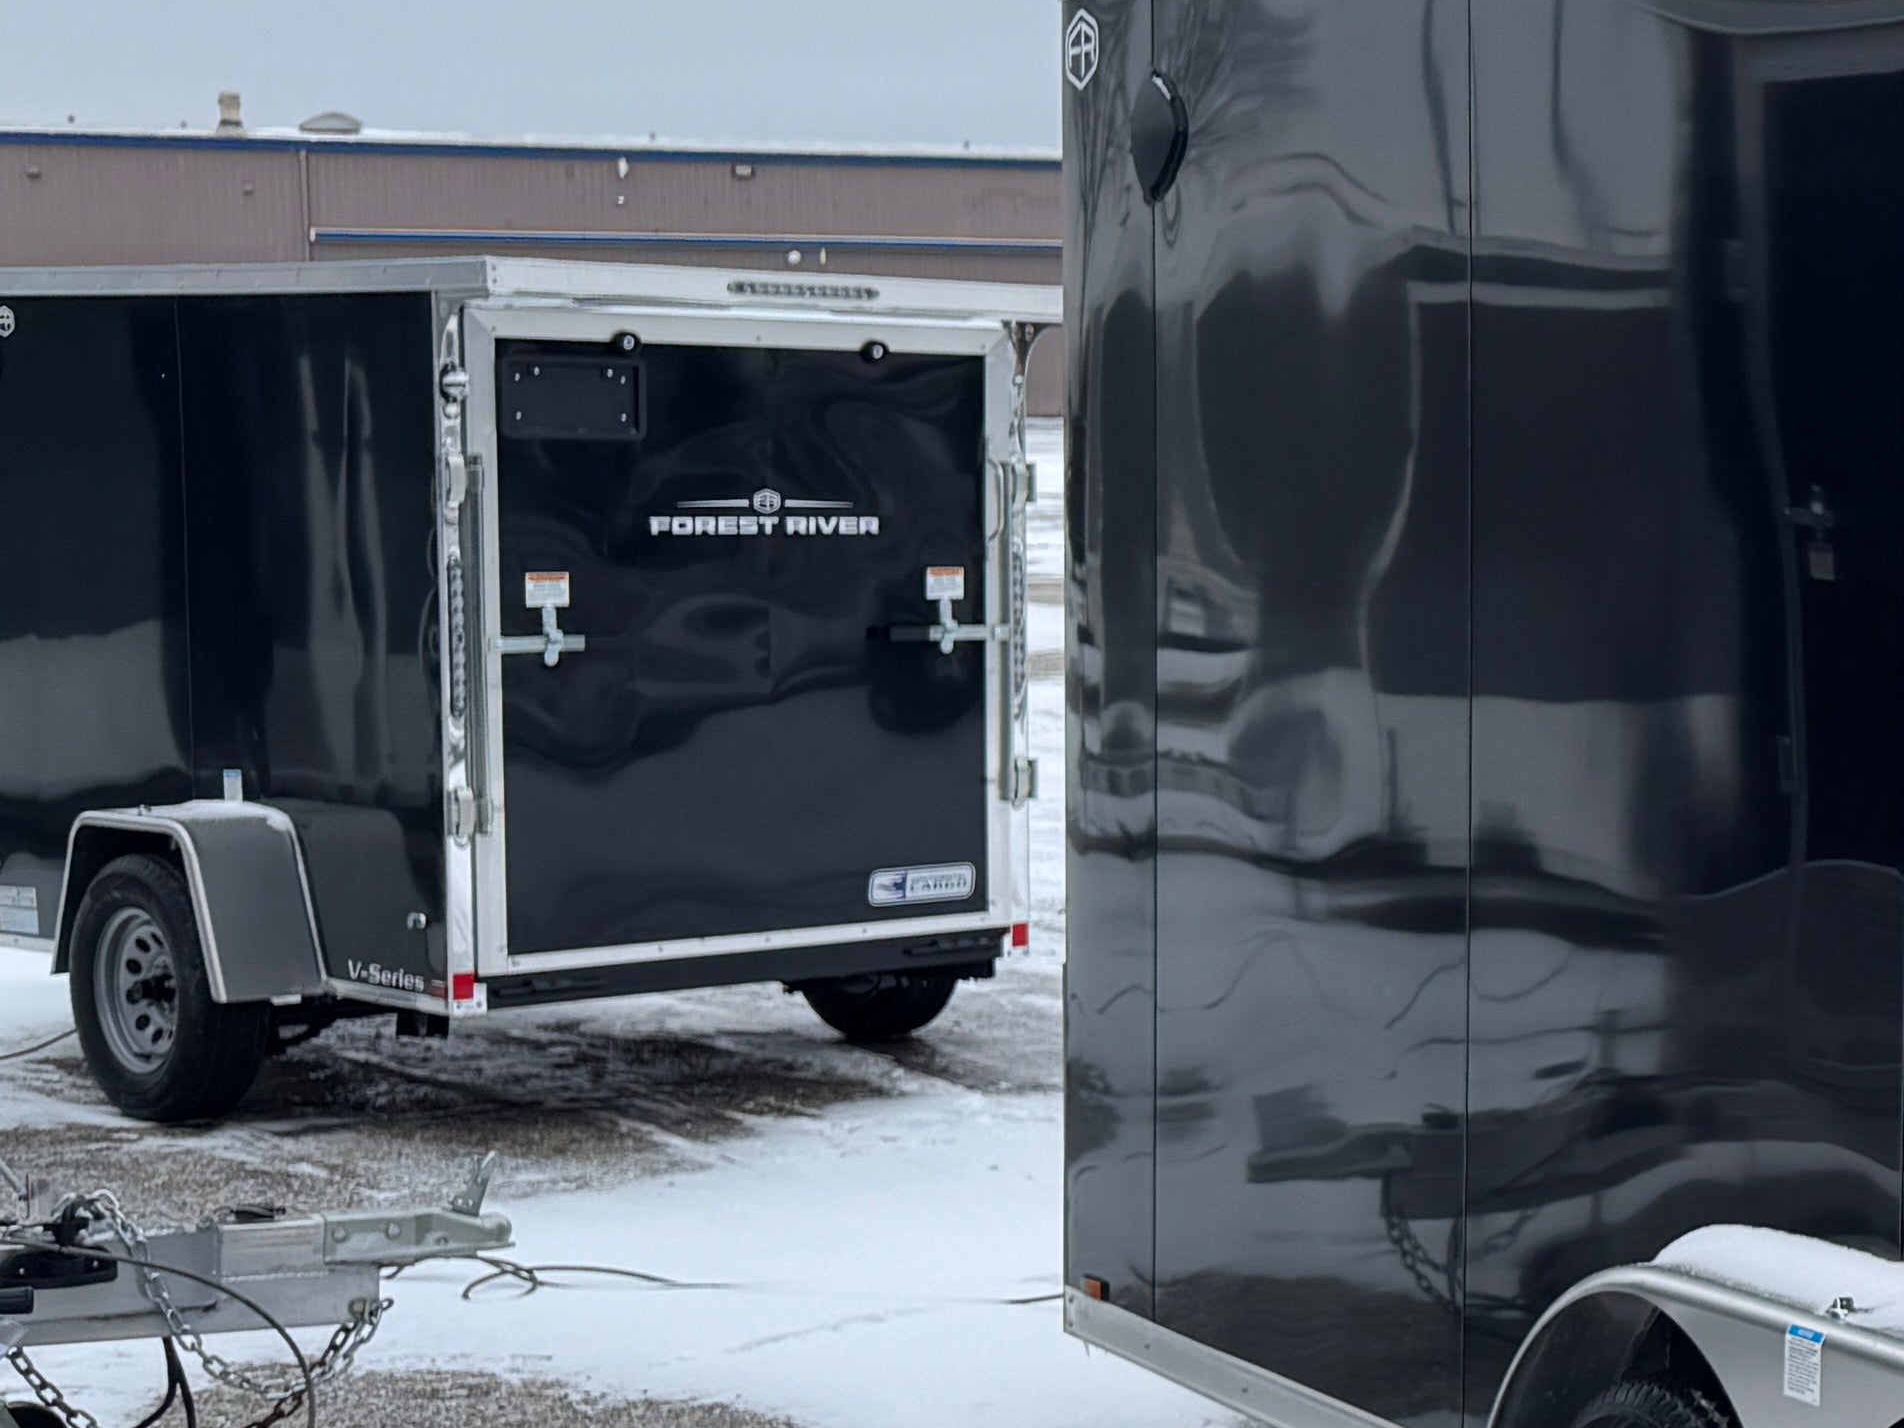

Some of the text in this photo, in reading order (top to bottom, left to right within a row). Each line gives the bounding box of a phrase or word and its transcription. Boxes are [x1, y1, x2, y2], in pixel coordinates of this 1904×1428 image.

[649, 515, 880, 536] FOREST RIVER
[348, 958, 424, 993] V-Series
